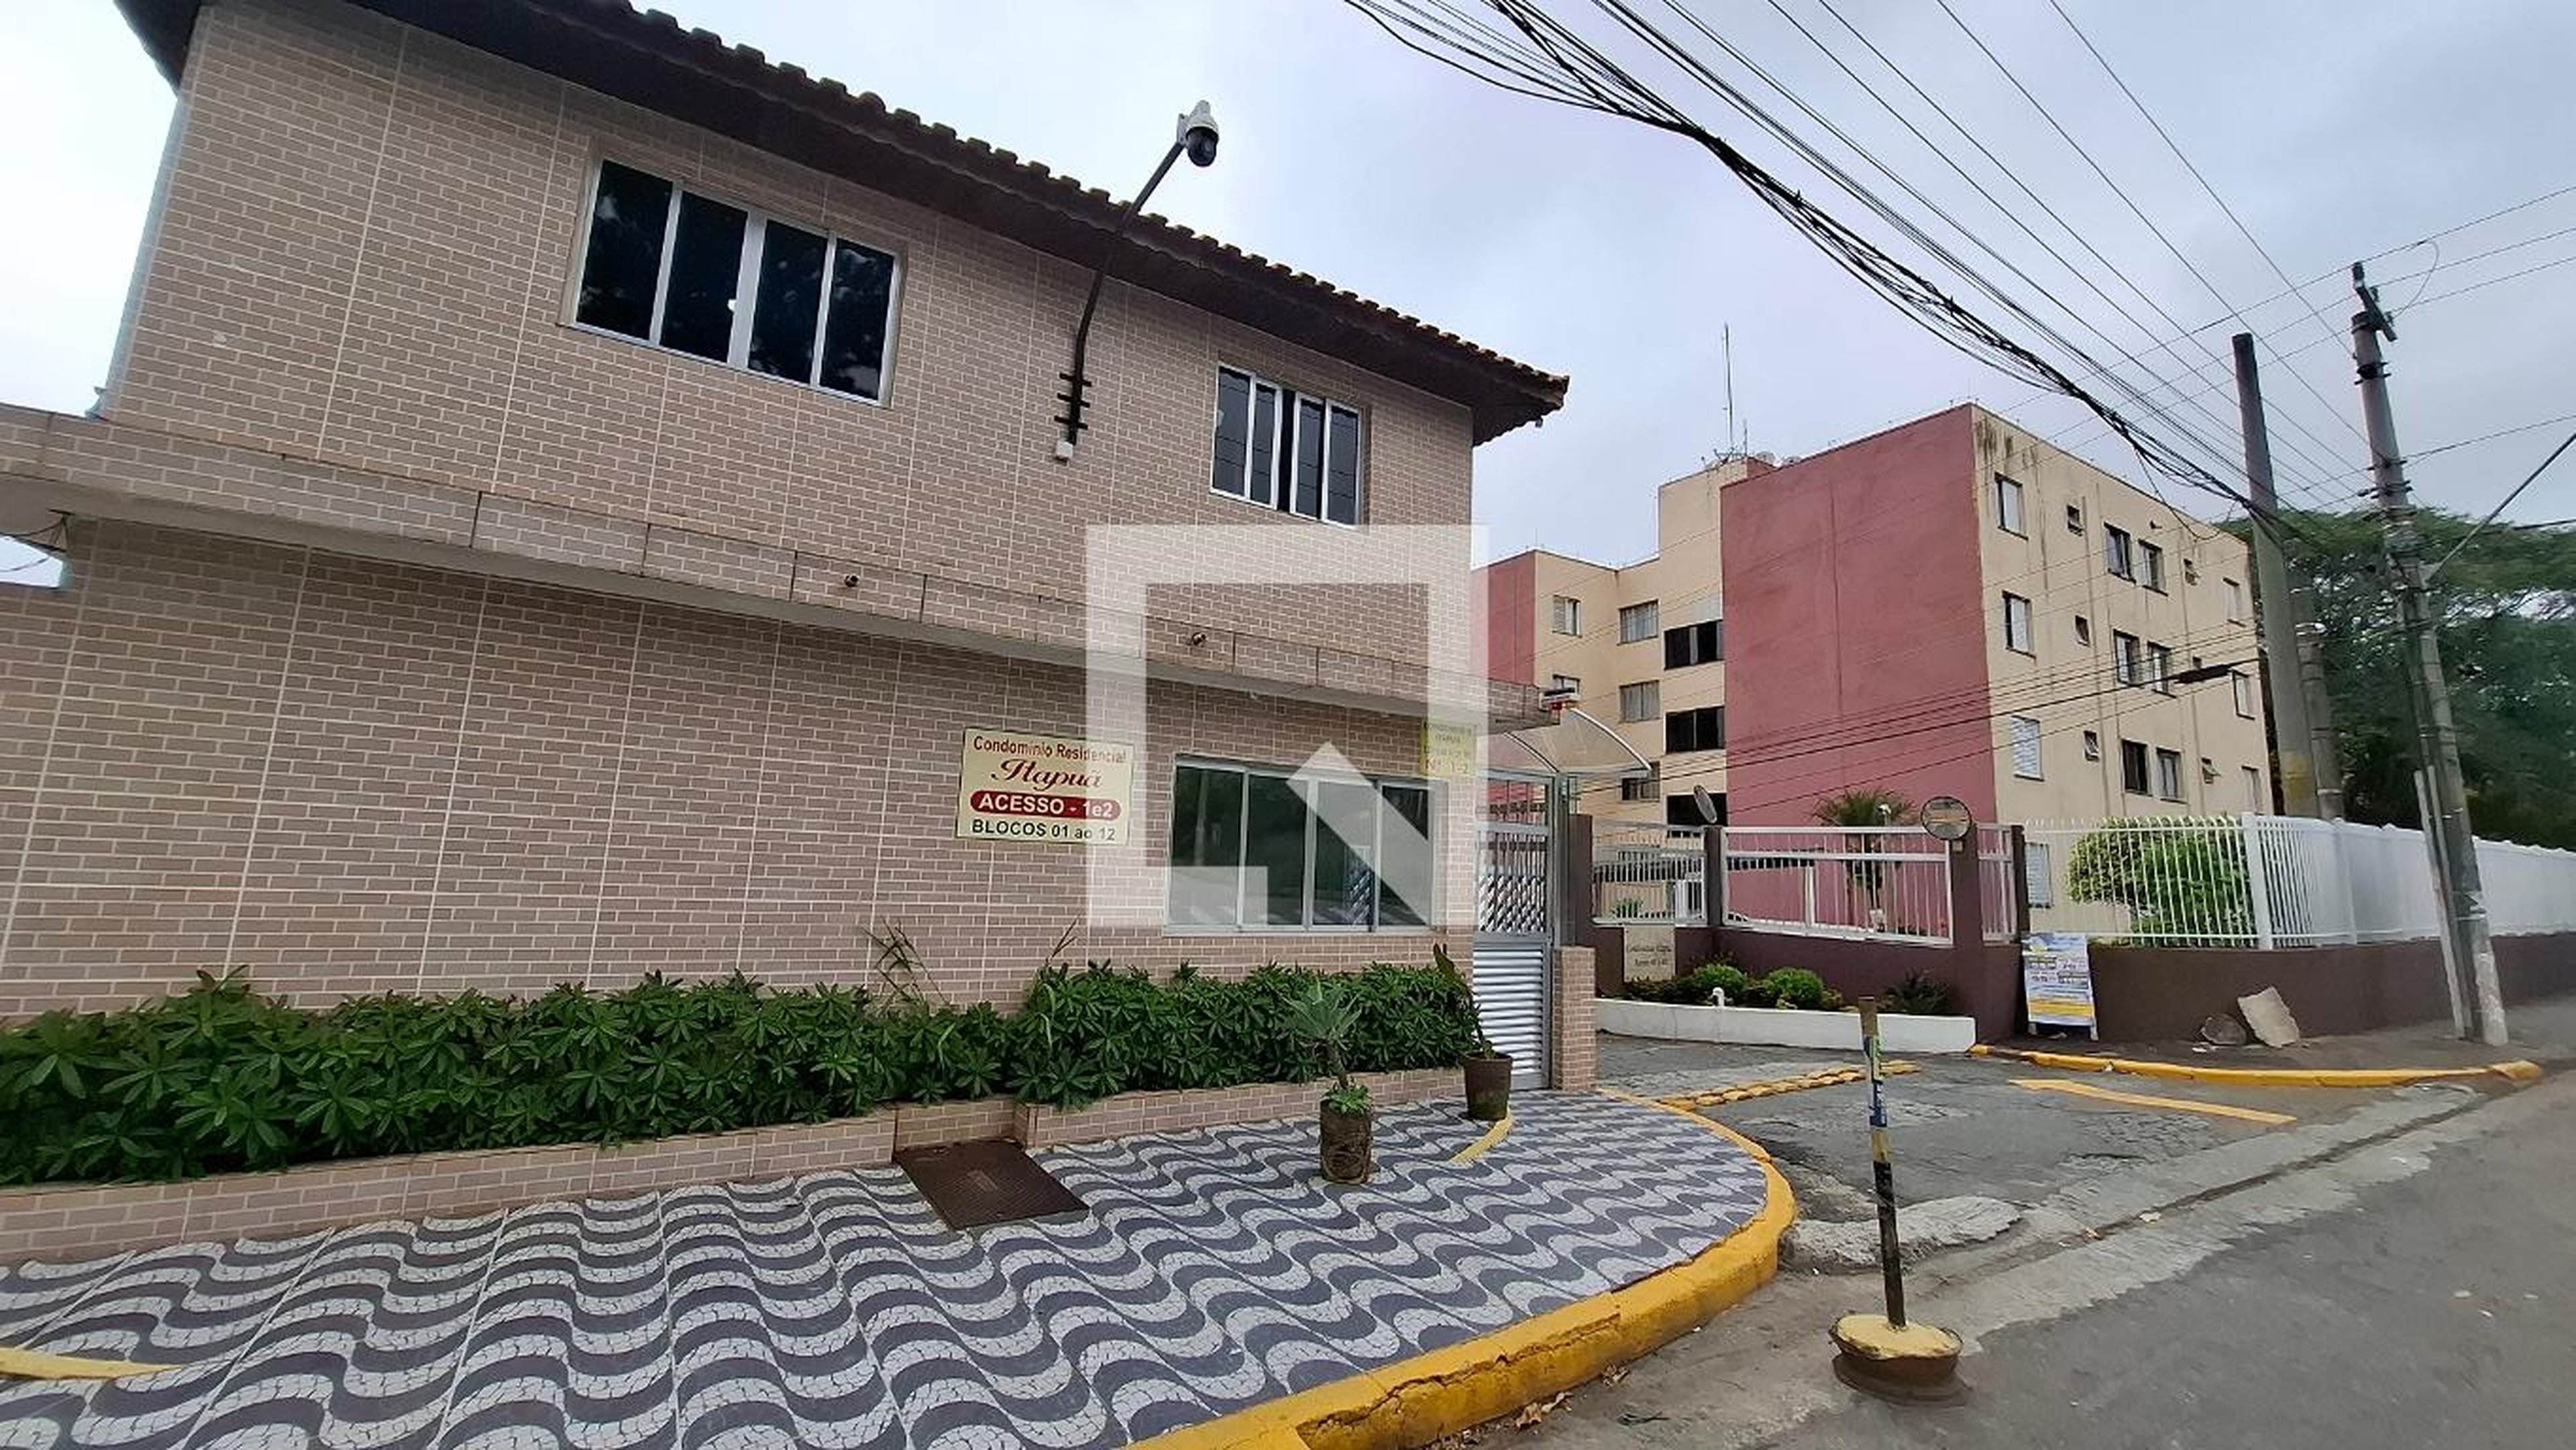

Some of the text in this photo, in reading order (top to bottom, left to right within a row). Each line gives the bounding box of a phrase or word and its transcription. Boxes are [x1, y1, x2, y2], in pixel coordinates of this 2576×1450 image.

[1057, 744, 1126, 763] Residencial
[979, 793, 1064, 814] ACESSO
[972, 819, 1116, 840] BLOCOS 01 ao 12
